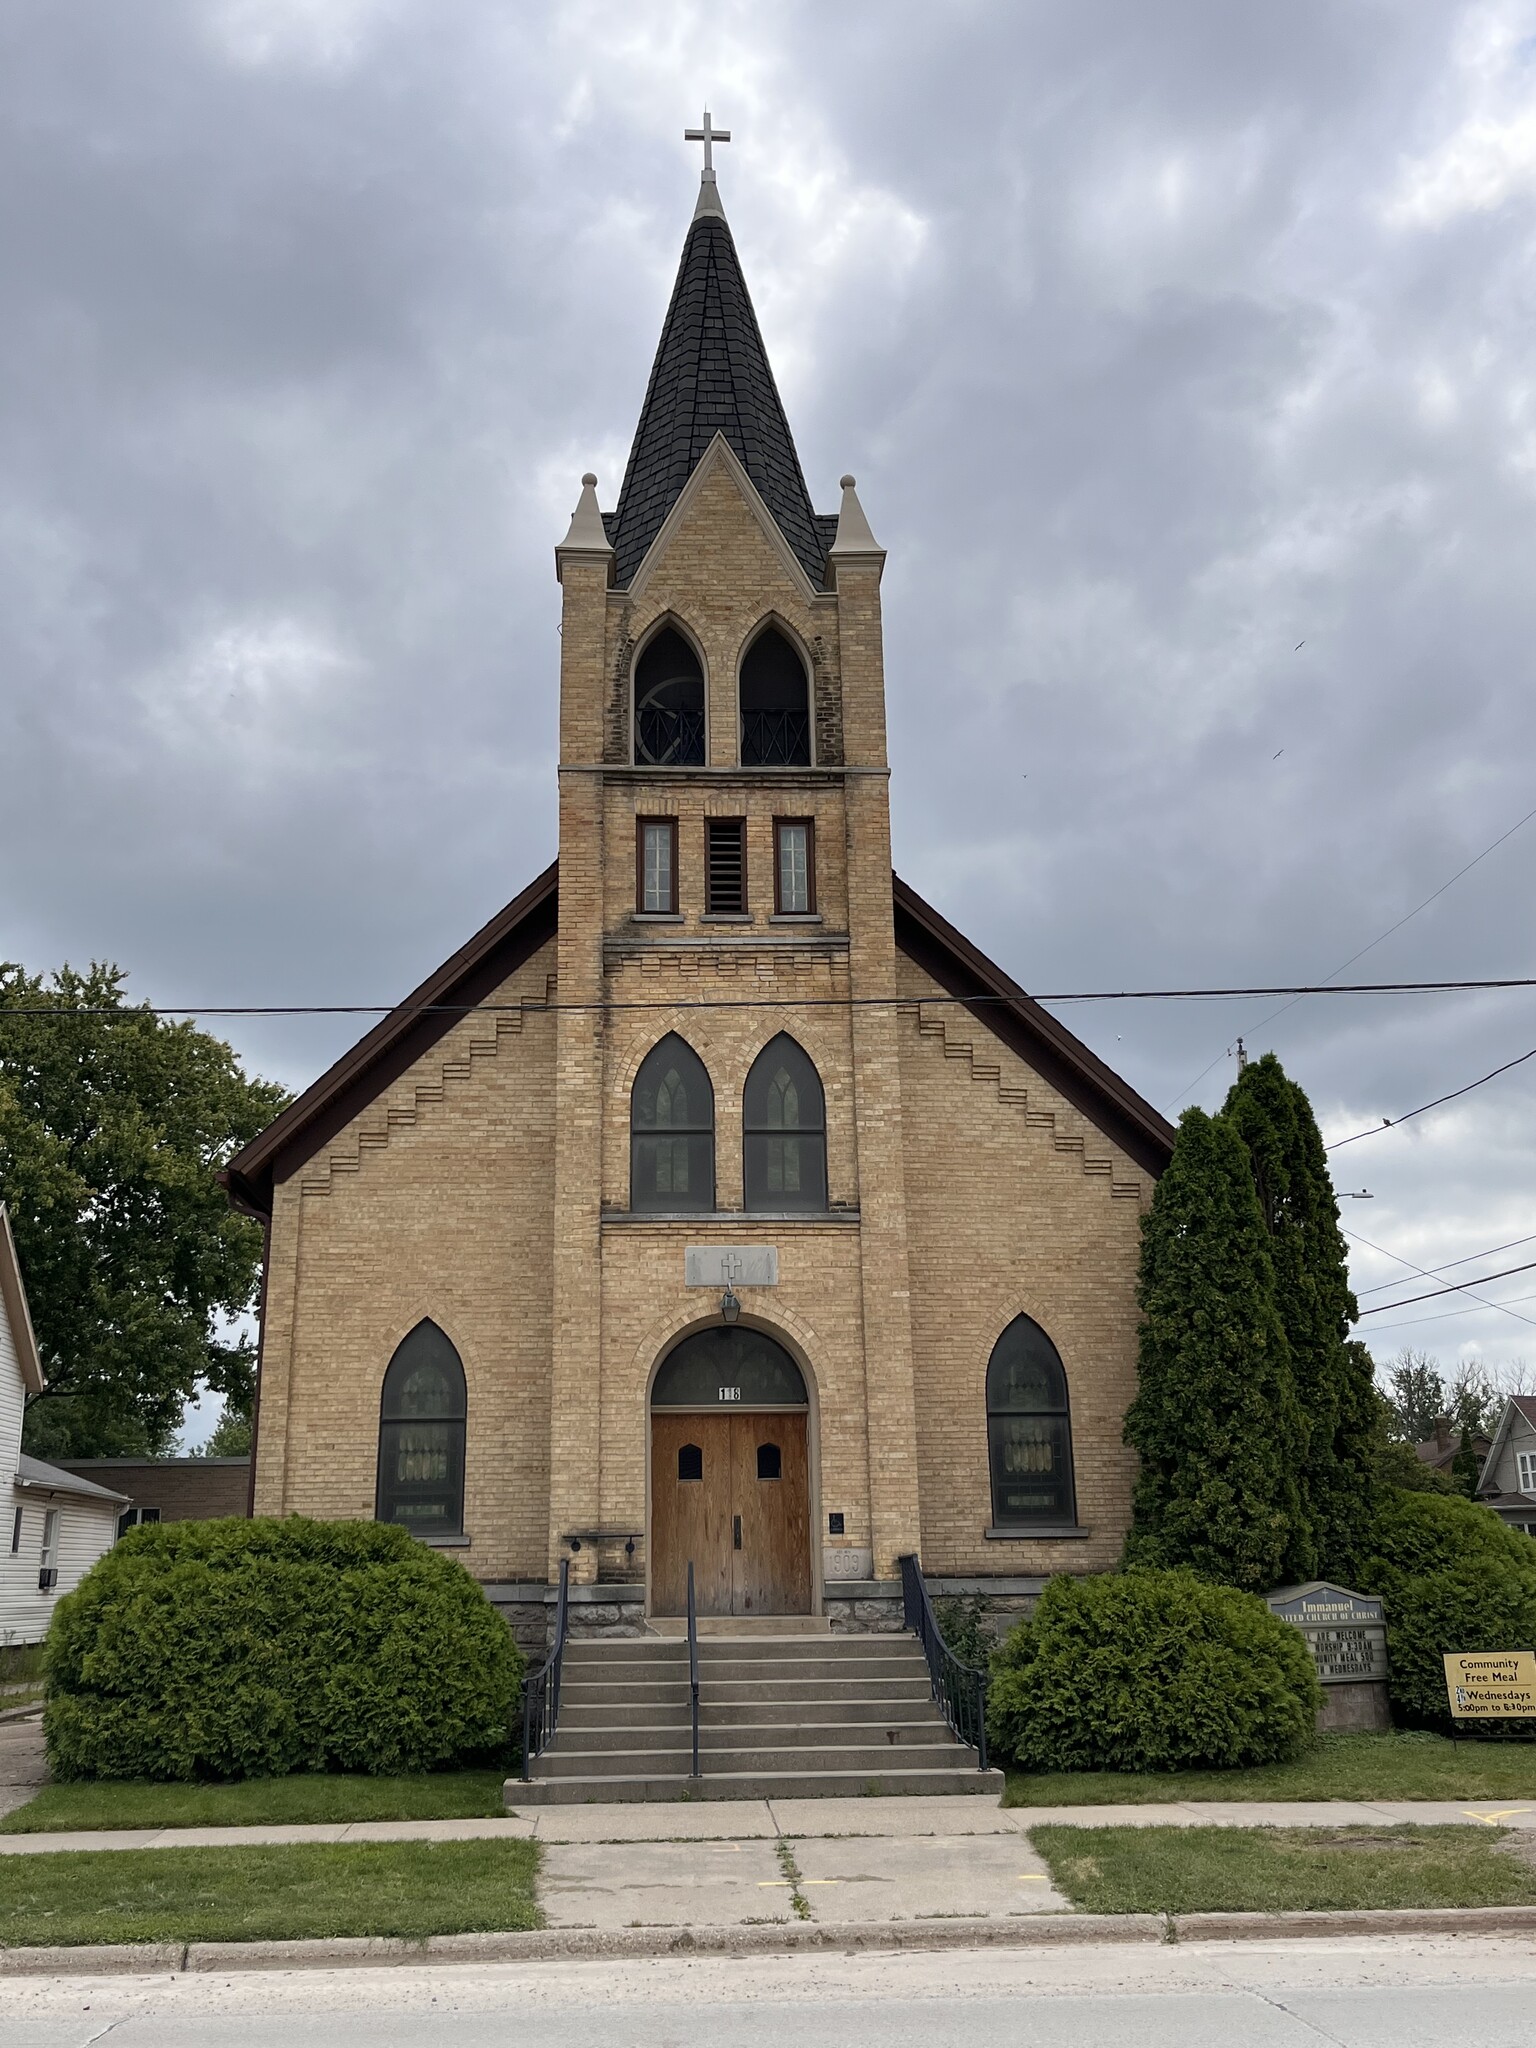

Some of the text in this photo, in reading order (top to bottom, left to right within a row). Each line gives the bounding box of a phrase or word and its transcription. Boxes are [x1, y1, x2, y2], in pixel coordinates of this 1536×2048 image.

[1302, 1600, 1353, 1613] Immanuel
[1280, 1611, 1378, 1622] NITED CHURCH OF CHRIST
[1317, 1631, 1330, 1641] ARE
[1336, 1630, 1366, 1640] WELCOME
[1315, 1641, 1373, 1652] WORSHIP 9:30AM
[1314, 1653, 1337, 1663] MUNITY
[1340, 1652, 1358, 1662] MEAL
[1330, 1663, 1372, 1674] WEDNESDAYS
[1459, 1659, 1519, 1670] Community
[1465, 1672, 1518, 1682] Free Meal
[1466, 1690, 1531, 1702] Wednesdays
[1458, 1704, 1488, 1713] 5:00pm
[1492, 1704, 1501, 1712] to
